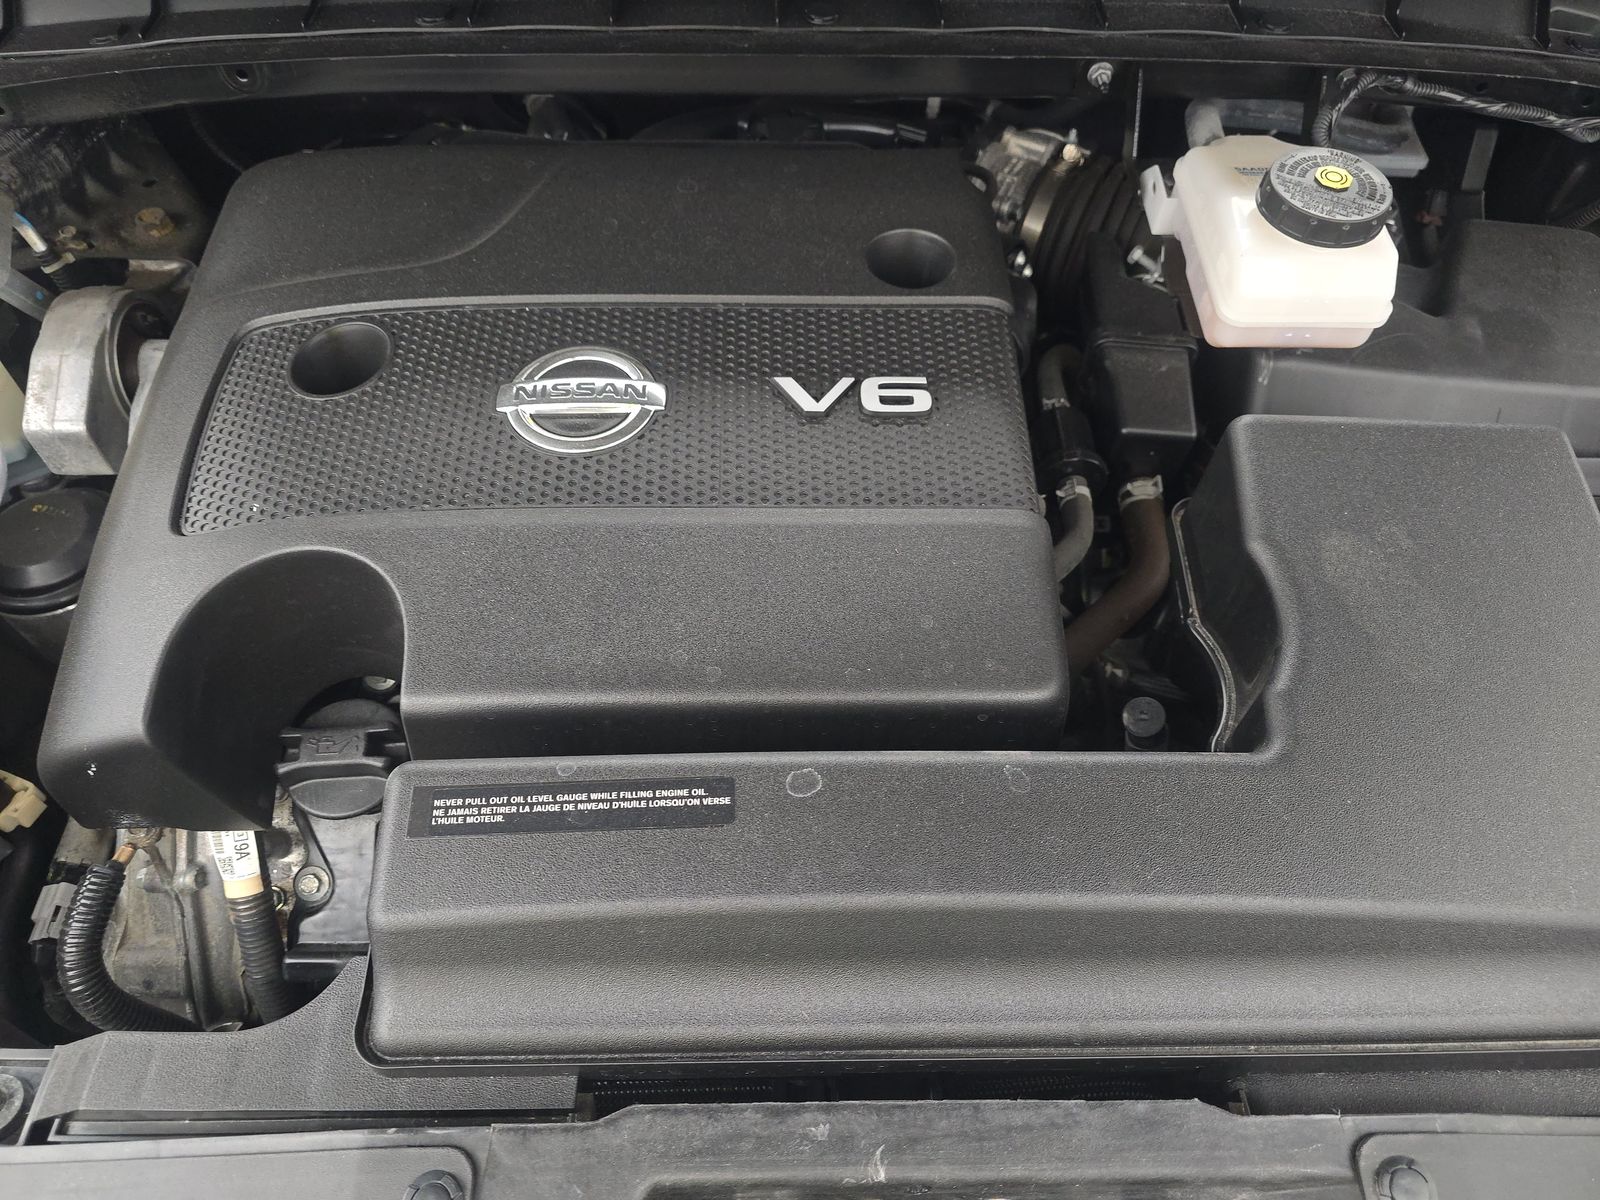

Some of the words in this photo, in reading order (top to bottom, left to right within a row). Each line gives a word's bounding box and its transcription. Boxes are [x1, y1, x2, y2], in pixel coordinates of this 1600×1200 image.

[514, 382, 648, 402] NISSAN
[771, 376, 933, 416] V6
[556, 793, 587, 801] GAUGE
[620, 790, 653, 798] FILLING
[447, 808, 478, 816] JAMAIS
[481, 806, 517, 814] RETIRER
[532, 804, 560, 812] JAUGE
[612, 800, 646, 808] D'HUILE
[649, 798, 700, 807] LORSQU'ON
[432, 817, 464, 825] L'HUILE
[466, 815, 504, 823] MOTEUR.
[234, 842, 250, 861] 9A
